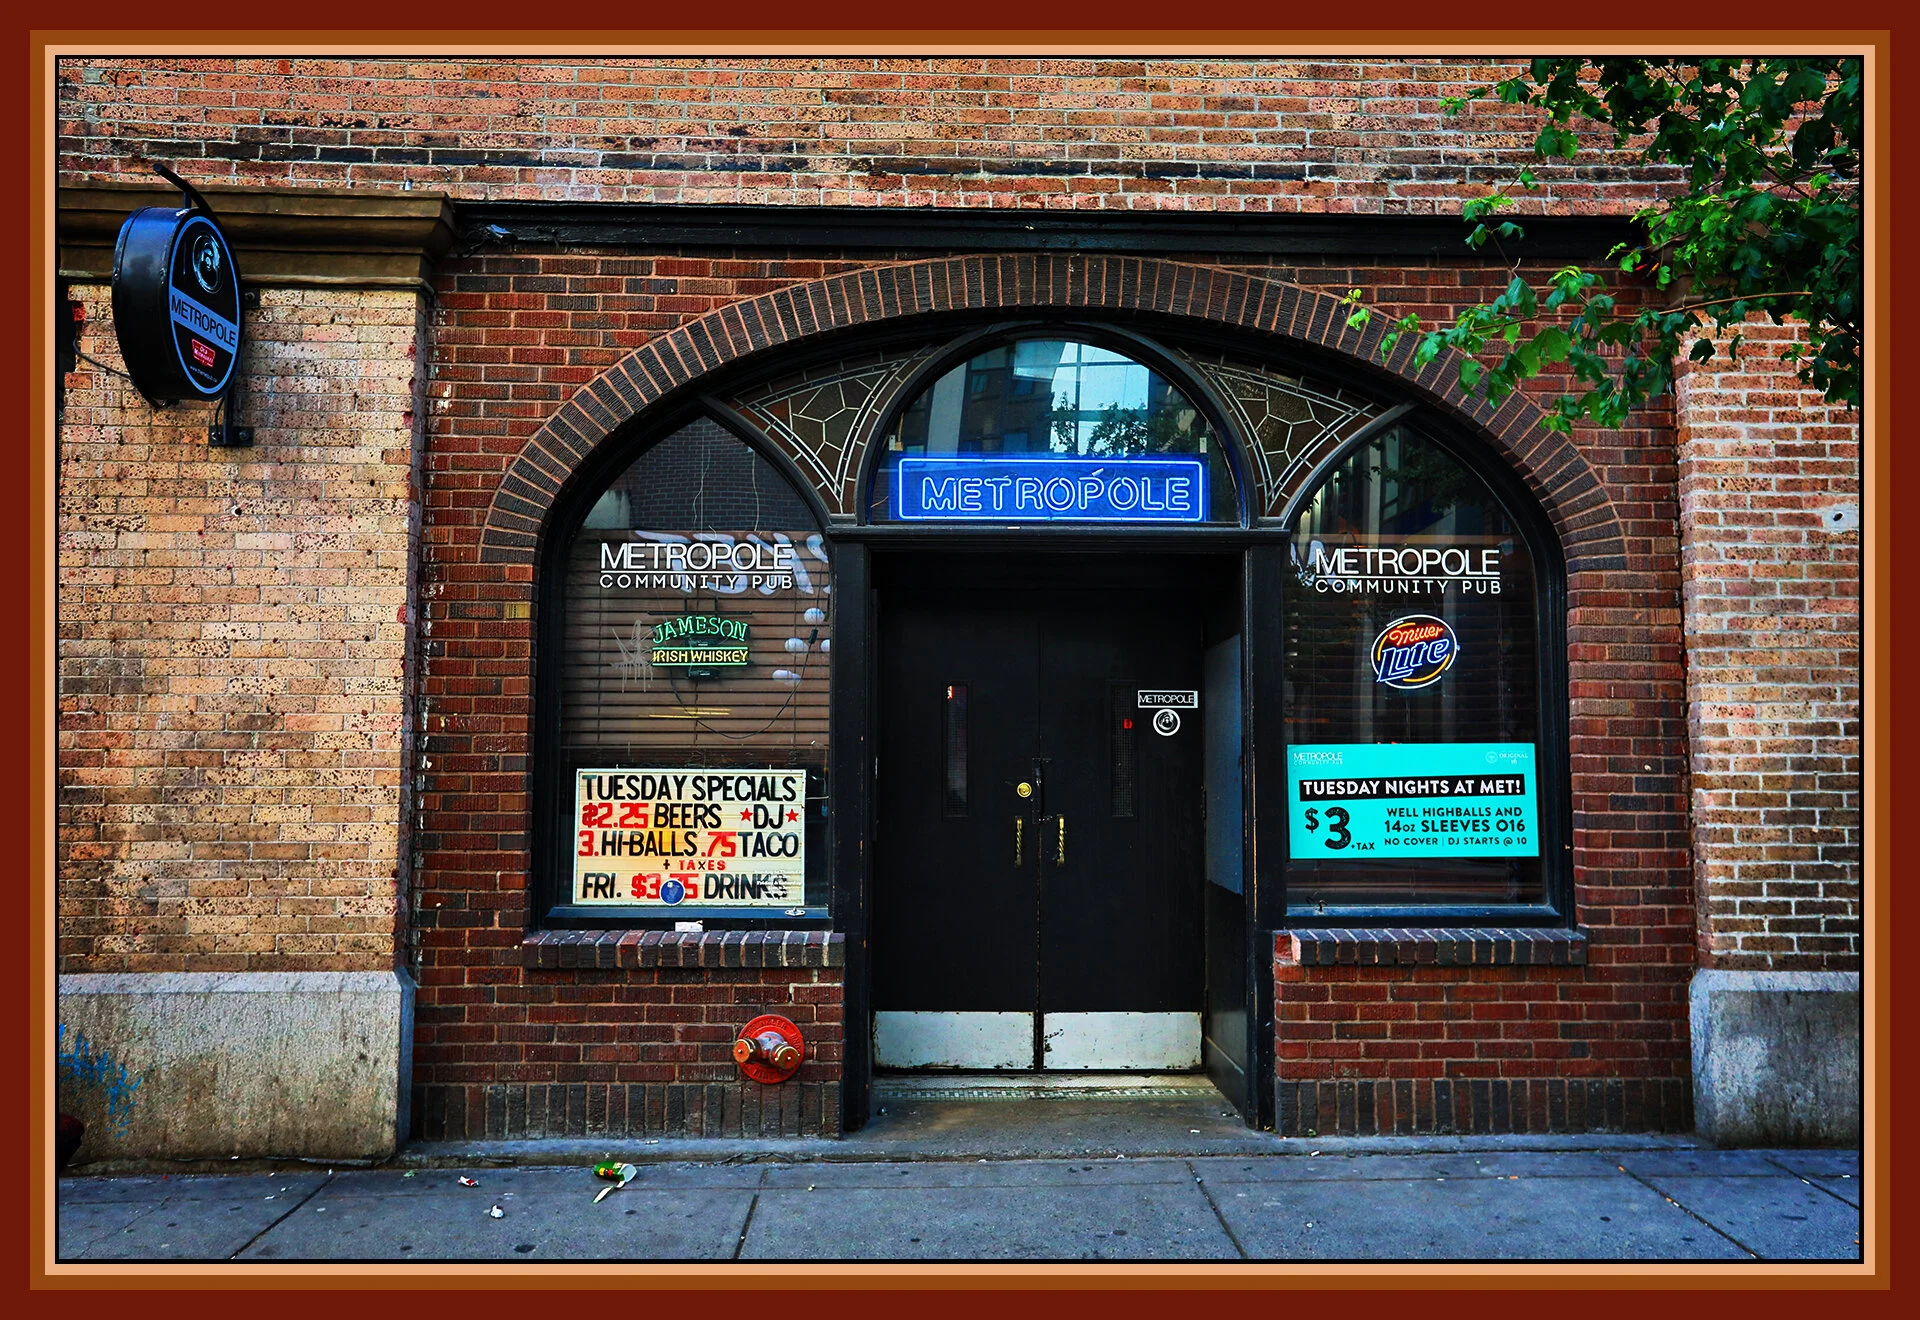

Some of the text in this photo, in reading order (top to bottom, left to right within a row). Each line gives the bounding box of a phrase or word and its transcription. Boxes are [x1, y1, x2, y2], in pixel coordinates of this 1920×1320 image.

[171, 295, 236, 347] METROPOLE
[922, 476, 1190, 511] METROPOLE
[601, 542, 792, 570] METROPOLE
[1315, 548, 1500, 576] METROPOLE
[600, 574, 793, 590] COMMUNITY PUB
[1315, 579, 1501, 595] COMMUNITY PUB
[652, 616, 748, 644] JAMESON
[652, 649, 748, 663] IRISH WHISKEY
[1139, 694, 1194, 703] METROPOLE
[1294, 752, 1343, 760] METROPOLE
[581, 774, 797, 801] TUESDAY SPECIALS
[1303, 779, 1521, 795] TUESDAY NIGHTS AT MET!
[581, 802, 785, 829] $2.25 BEERS DJ
[1386, 807, 1523, 817] WELL HIGHBALLS AND
[1384, 820, 1415, 832] 14oz
[1421, 819, 1491, 832] SLEEVES
[601, 831, 697, 857] HI-BALLS
[738, 831, 799, 857] TACO
[1384, 836, 1527, 847] NO COVER DJ STARTS @ 10
[679, 859, 726, 871] TAXES
[582, 873, 621, 898] FRI.
